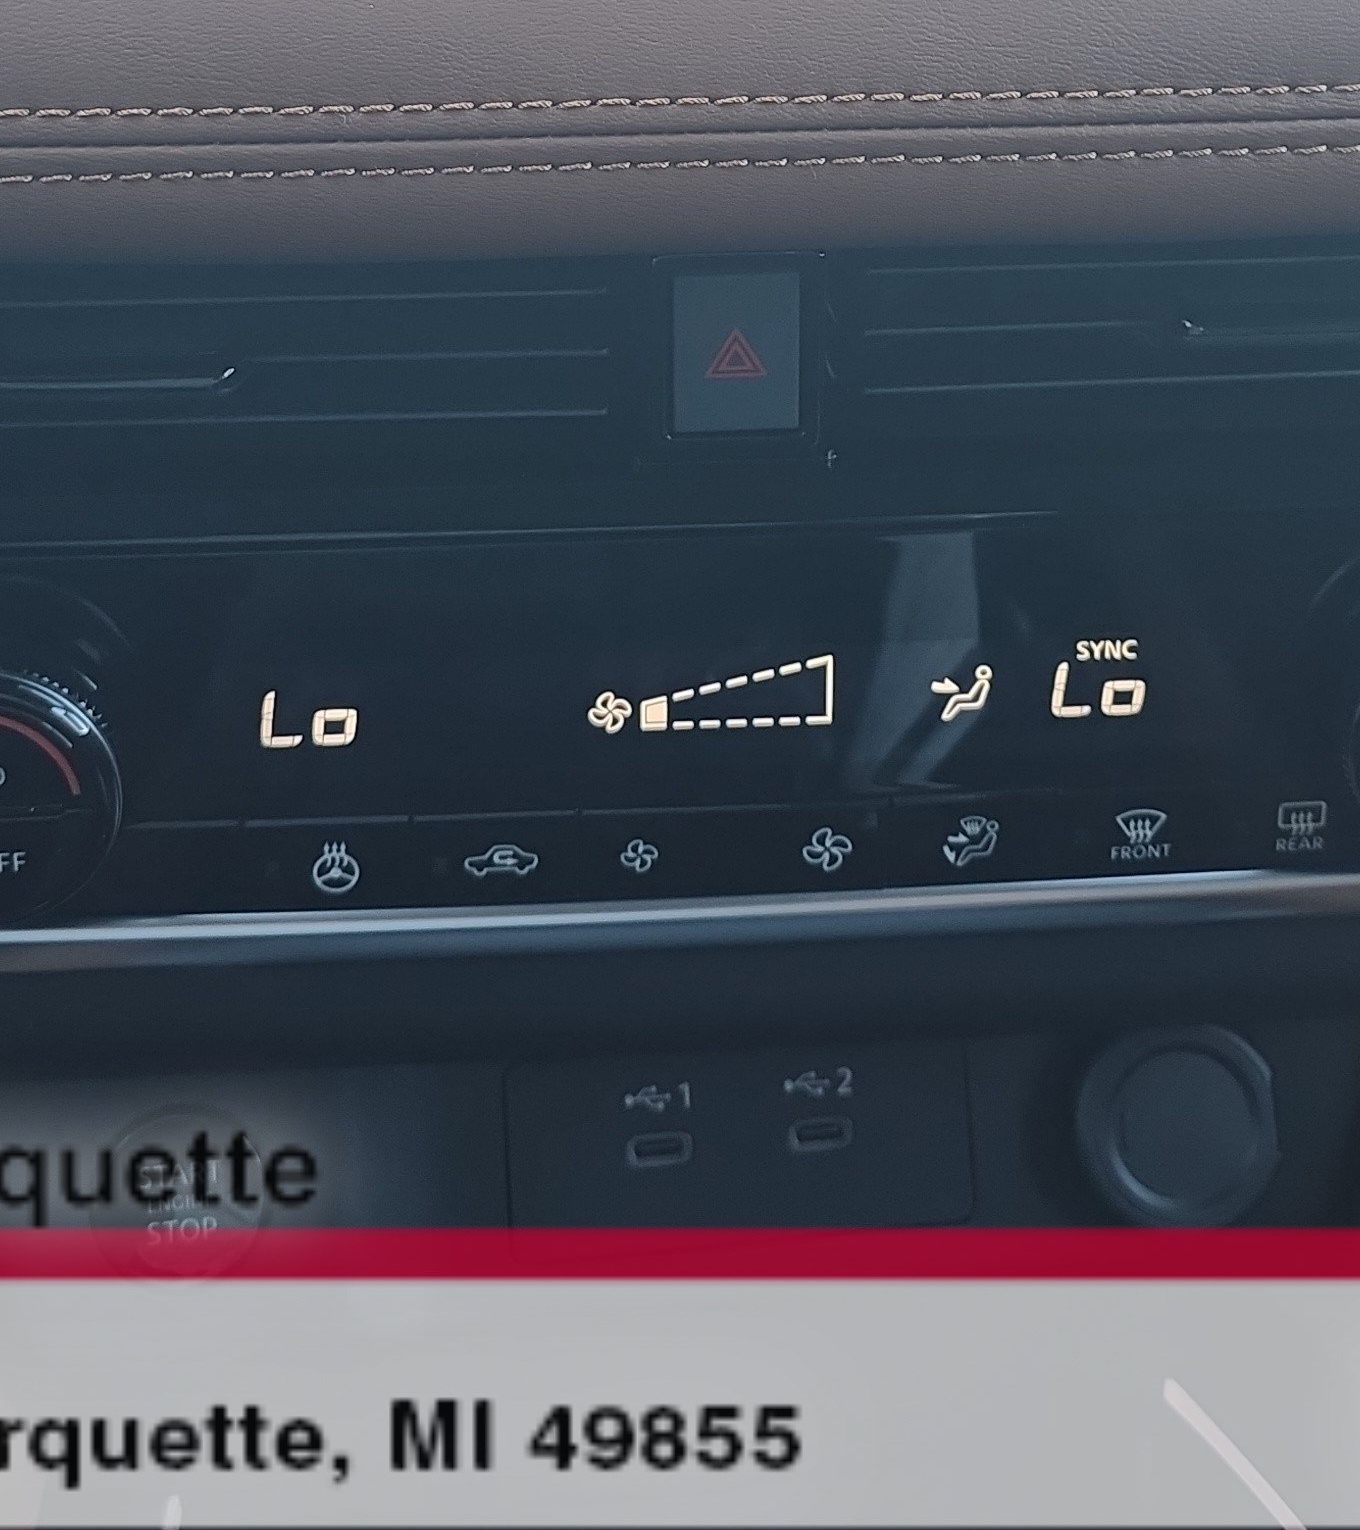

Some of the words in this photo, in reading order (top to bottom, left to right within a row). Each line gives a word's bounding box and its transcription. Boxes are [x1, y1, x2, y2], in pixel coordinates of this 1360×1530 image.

[1075, 638, 1139, 662] SYNC
[1050, 661, 1147, 719] Lo
[259, 689, 359, 749] Lo
[1110, 841, 1173, 861] FRONT
[1276, 836, 1324, 852] REAR
[837, 1067, 853, 1095] 2
[678, 1082, 691, 1108] 1
[147, 1216, 218, 1245] STOP
